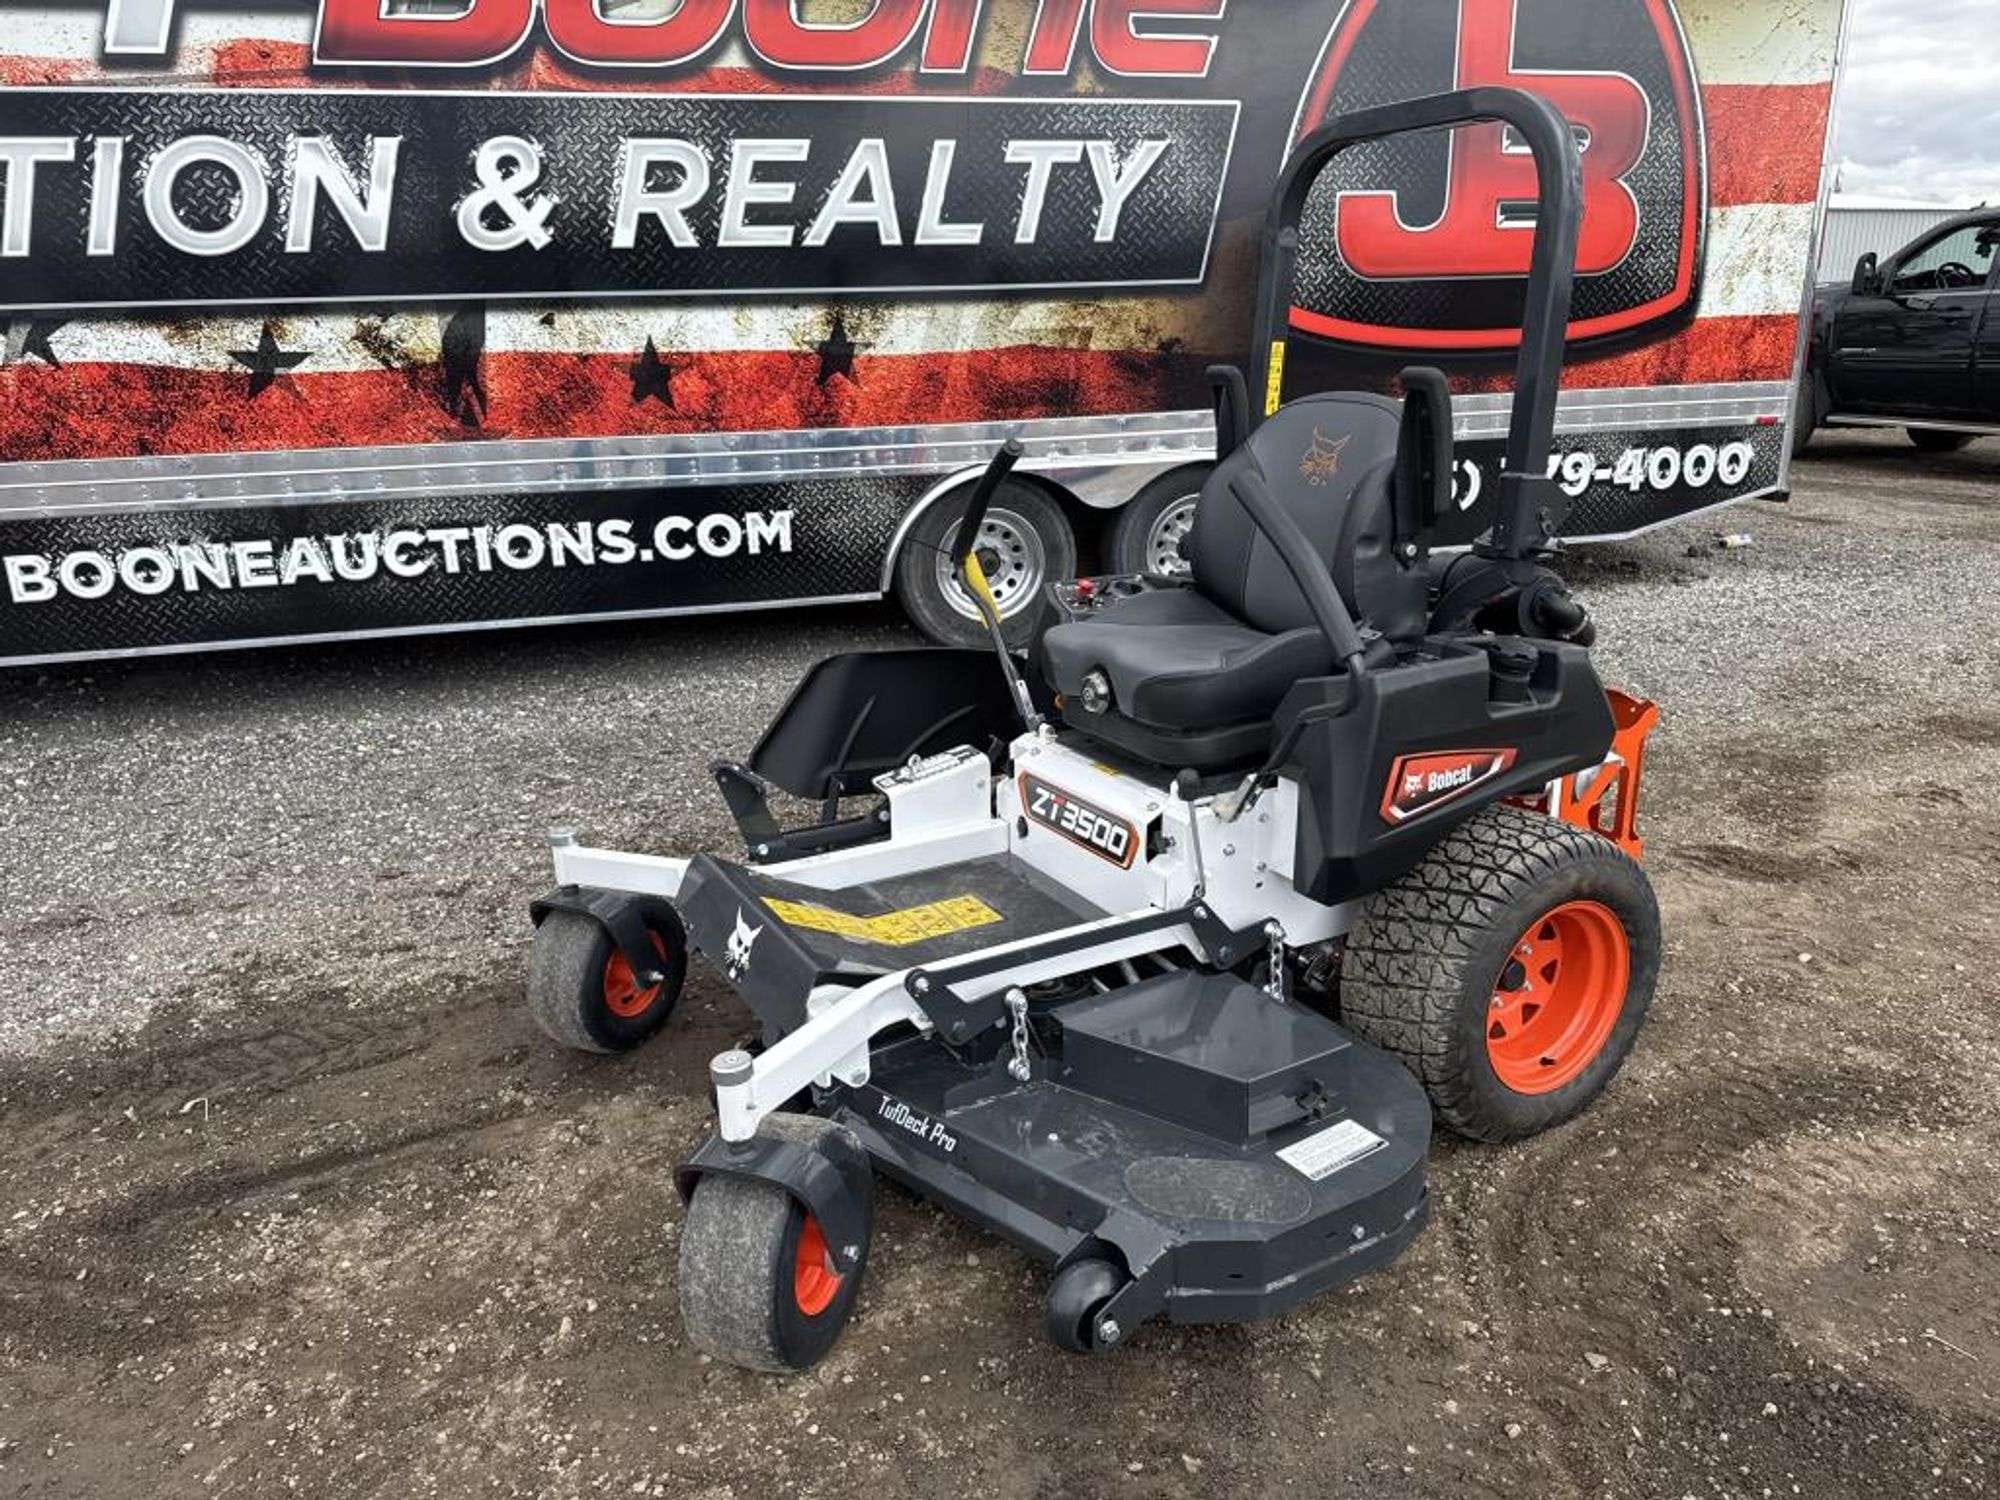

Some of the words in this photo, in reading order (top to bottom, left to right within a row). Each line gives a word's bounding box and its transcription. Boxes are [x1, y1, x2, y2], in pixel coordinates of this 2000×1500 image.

[456, 135, 557, 252] &
[611, 138, 1170, 249] REALTY
[3, 509, 796, 602] BOONEAUCTIONS.COM
[1428, 764, 1473, 792] Bobcat
[878, 1095, 930, 1138] TufDeck
[929, 1122, 957, 1152] Pro
